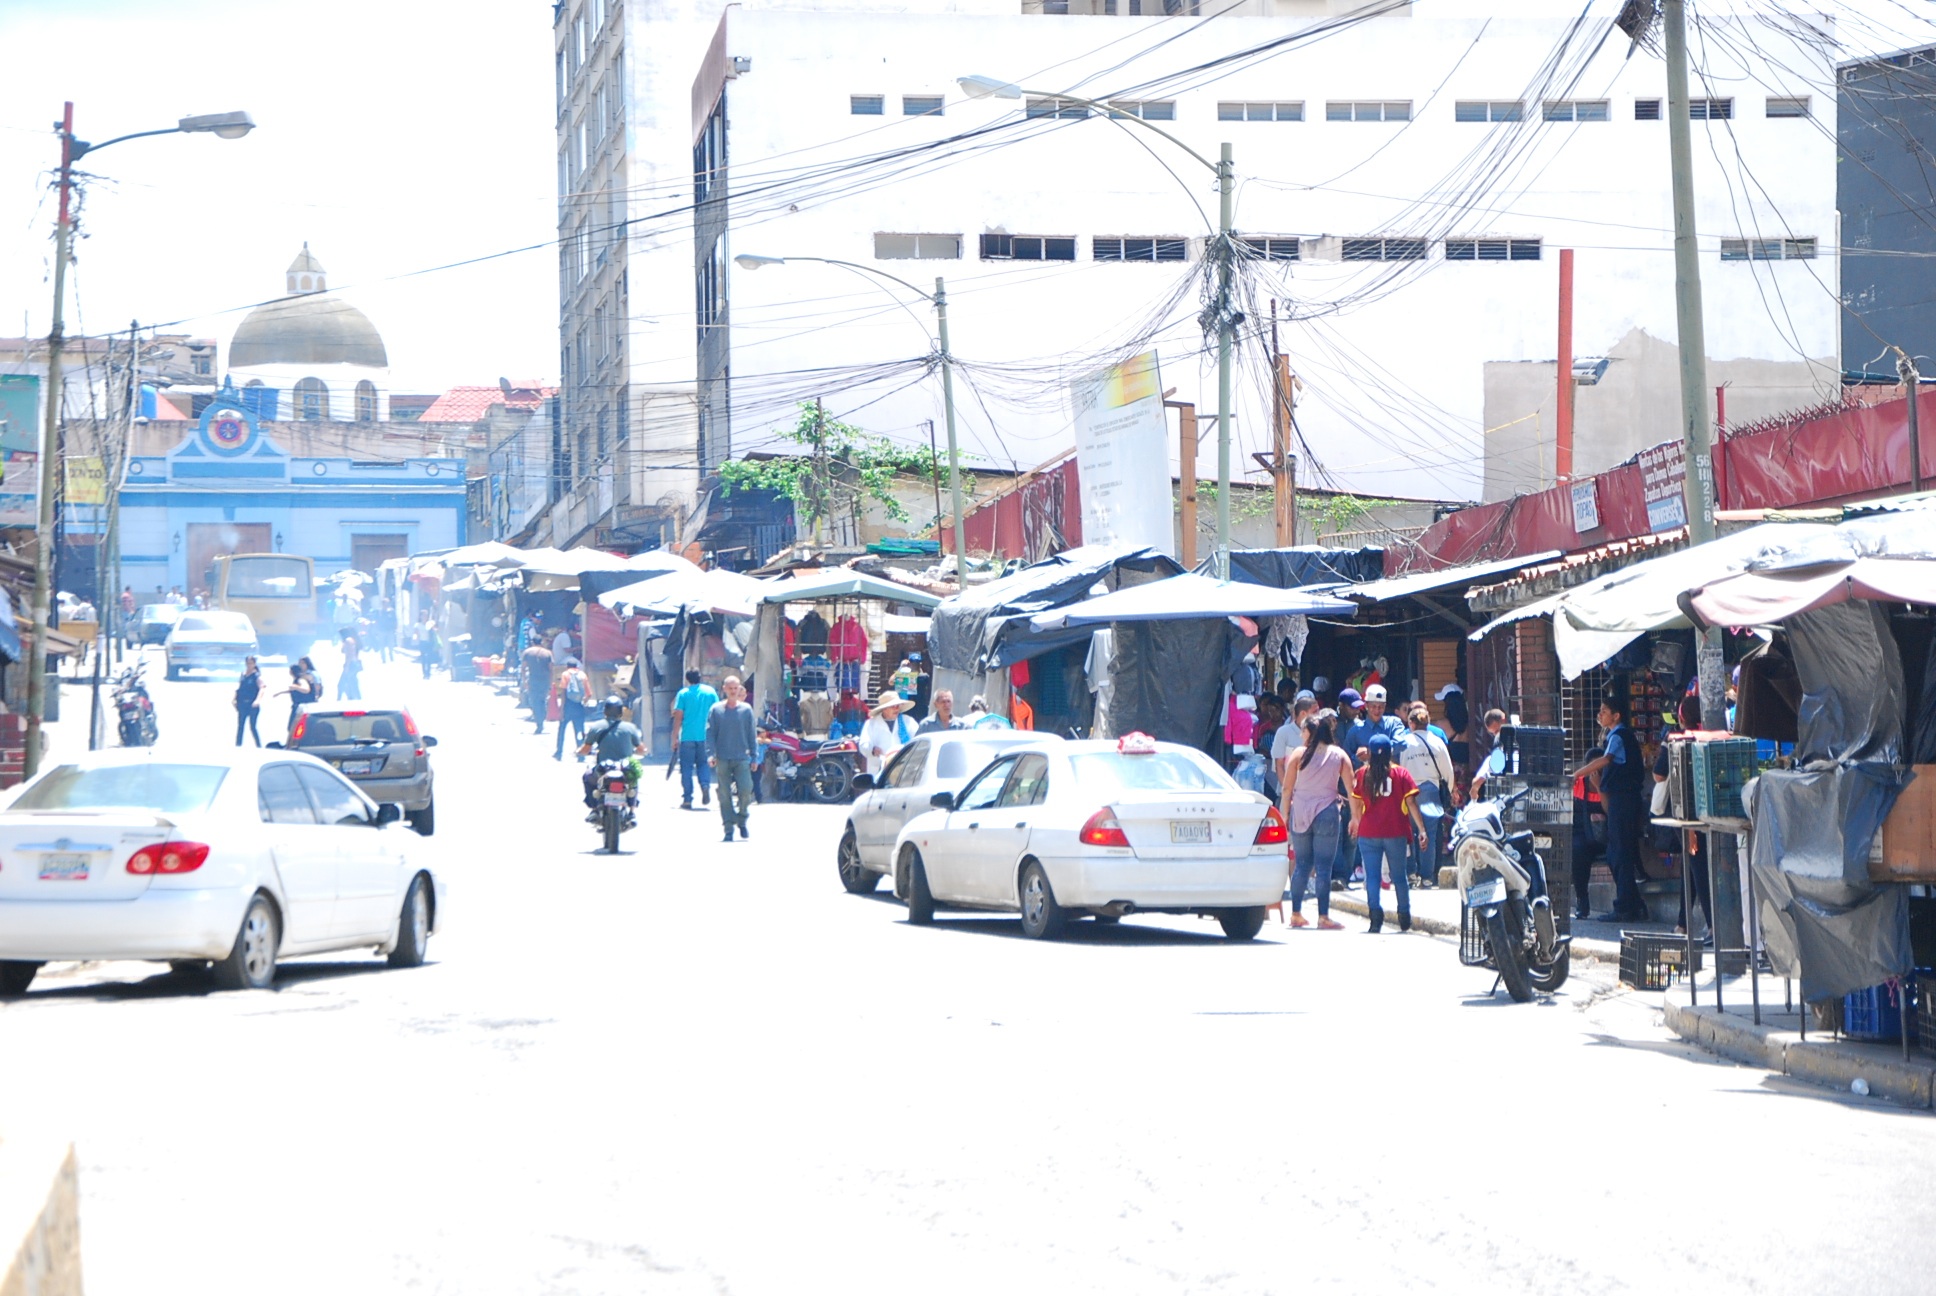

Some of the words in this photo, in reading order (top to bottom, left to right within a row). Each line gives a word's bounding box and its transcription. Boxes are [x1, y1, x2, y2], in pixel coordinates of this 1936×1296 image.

[1696, 454, 1709, 467] 56
[1644, 485, 1661, 502] Zapatos
[1660, 480, 1682, 498] Deportivos
[1648, 503, 1677, 527] CONVERSE
